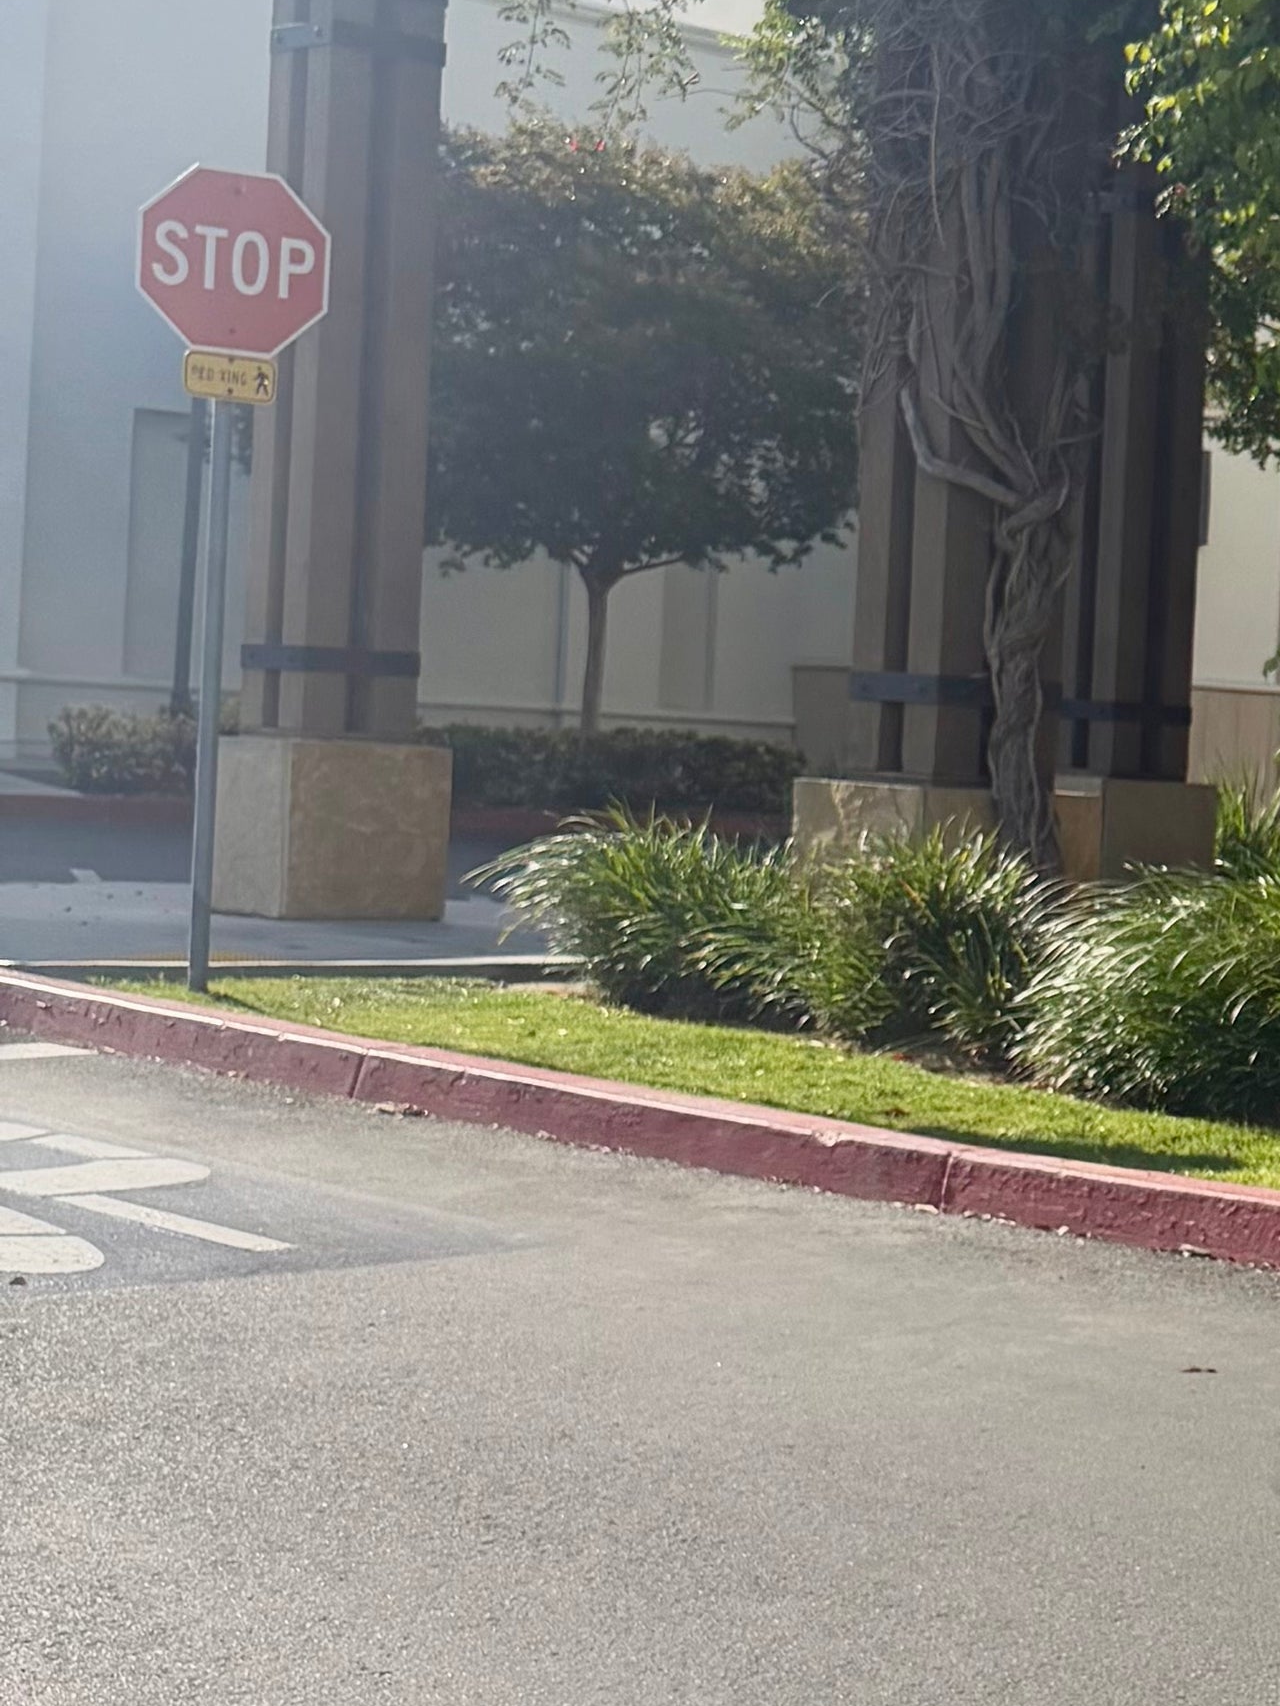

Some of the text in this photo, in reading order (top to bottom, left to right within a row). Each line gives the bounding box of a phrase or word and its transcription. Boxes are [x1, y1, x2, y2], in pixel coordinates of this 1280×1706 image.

[152, 220, 315, 299] STOP
[191, 364, 247, 386] PED XING
